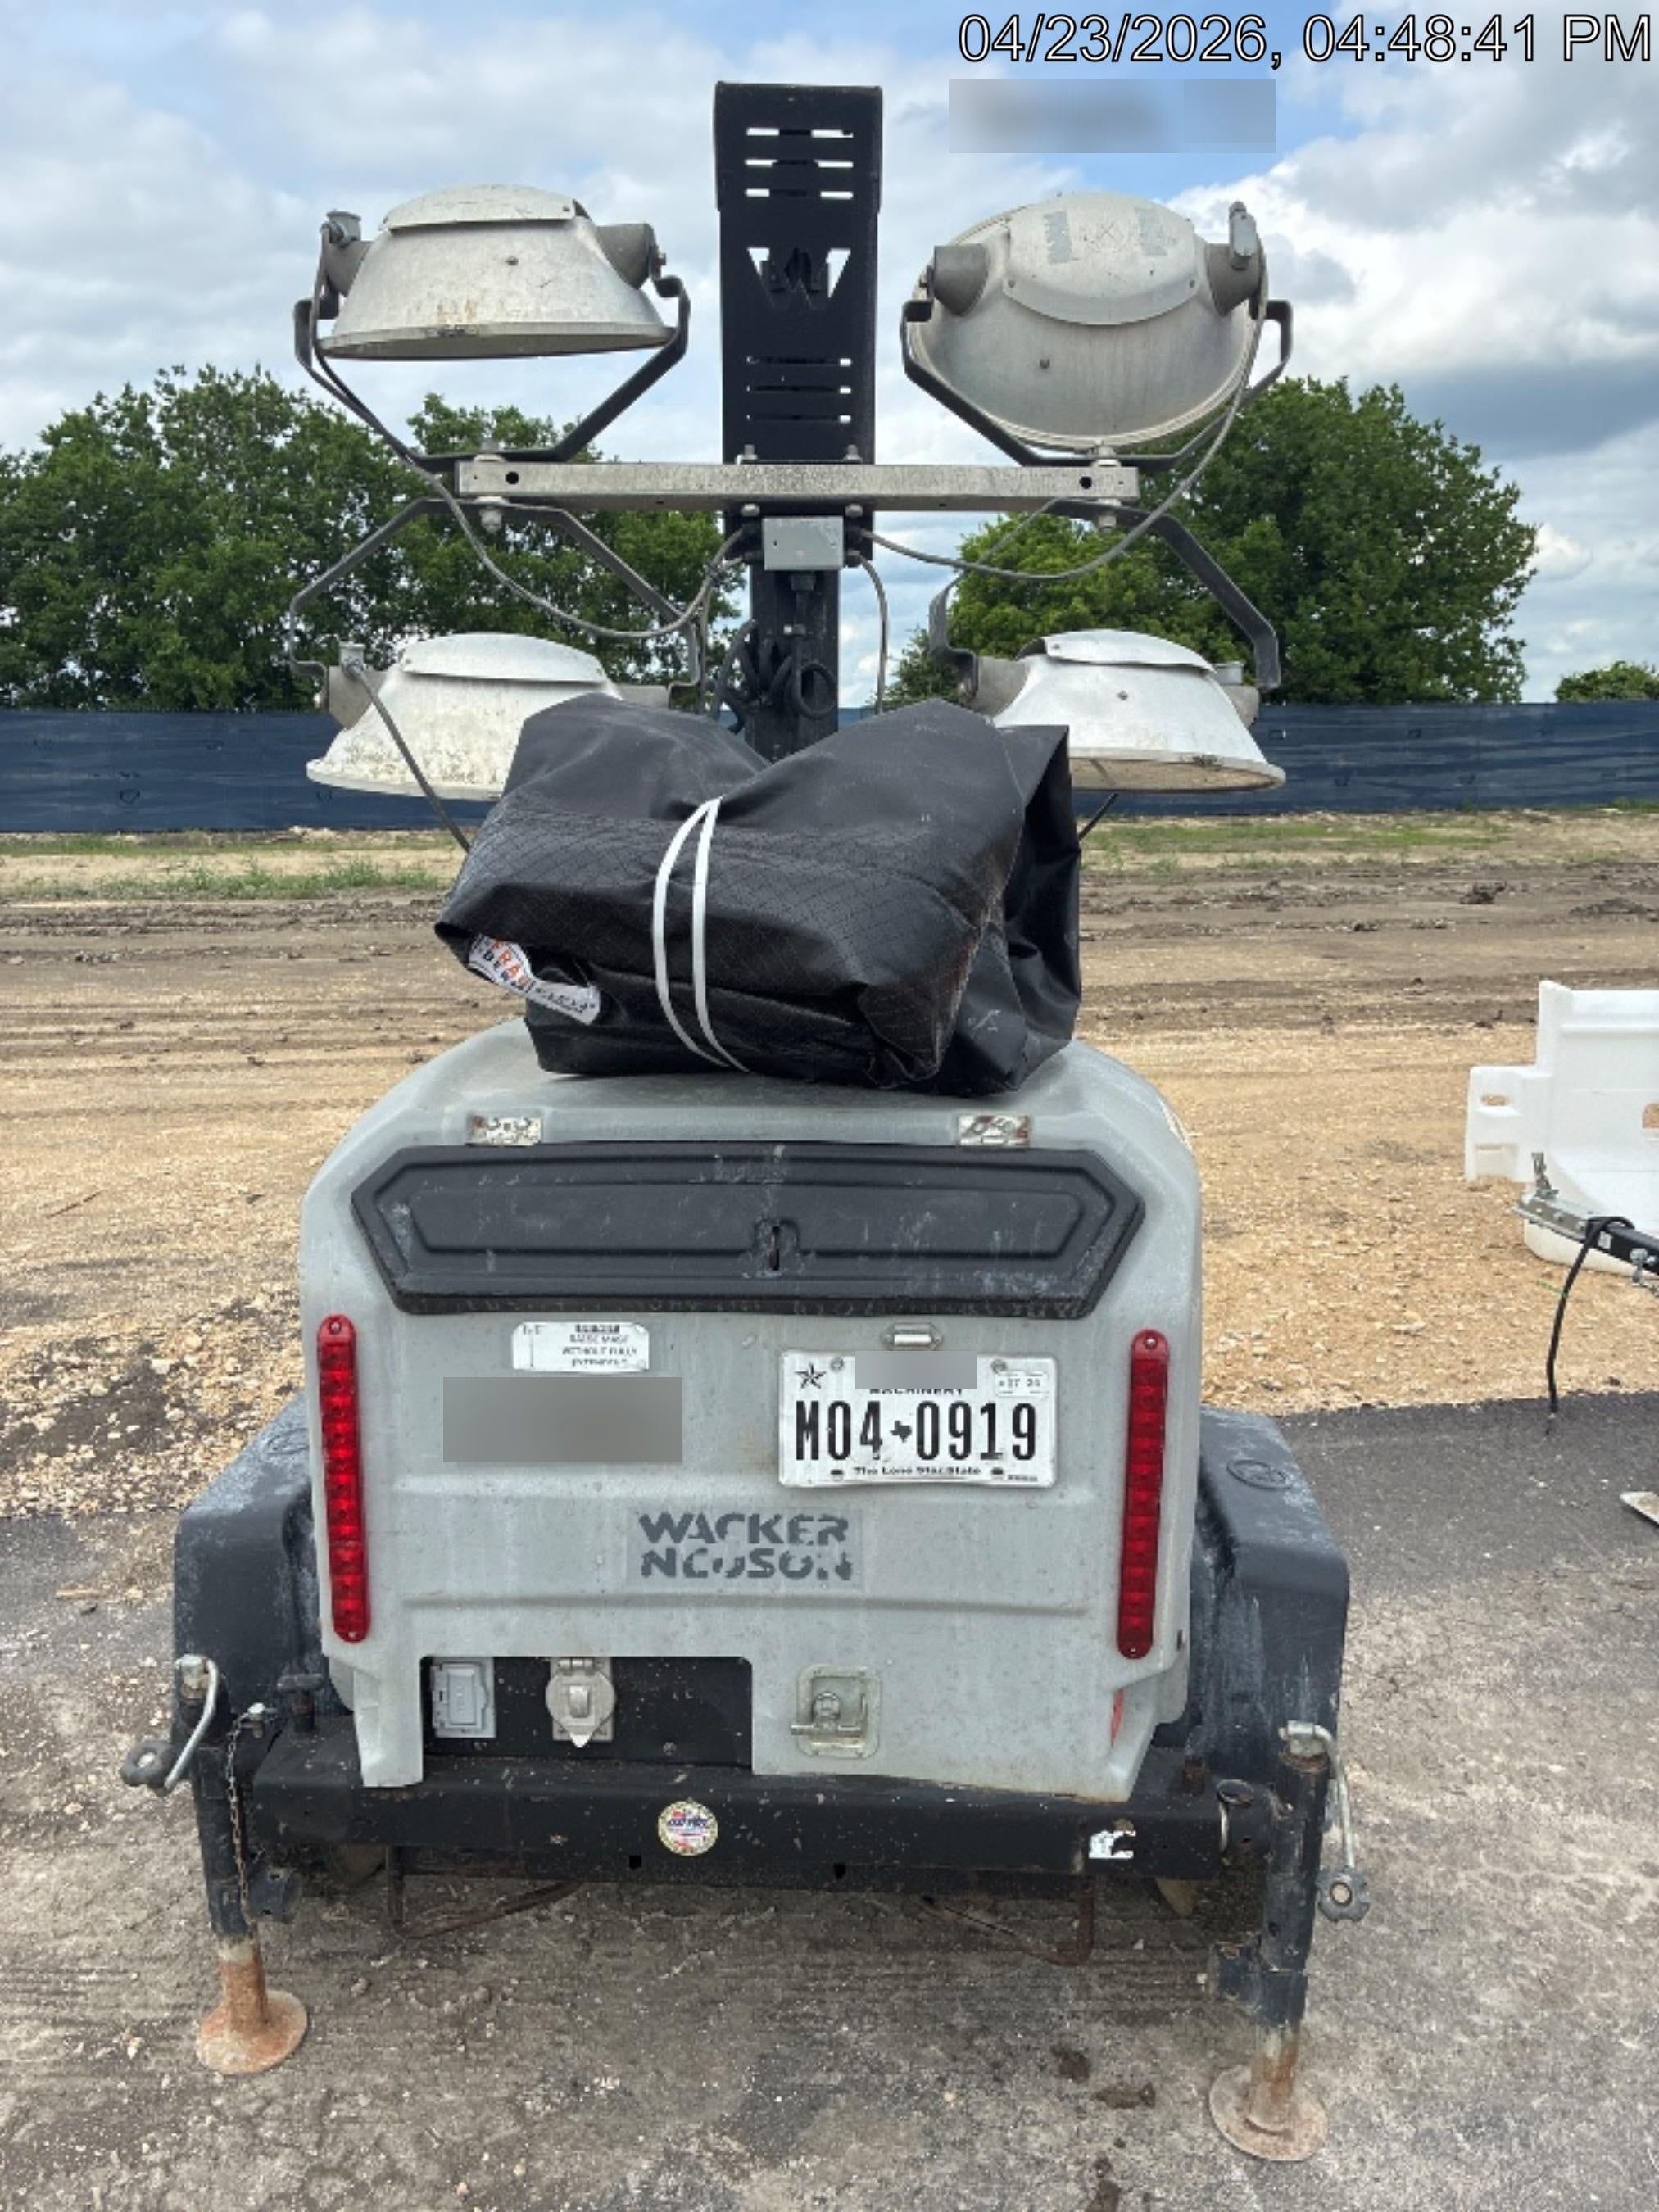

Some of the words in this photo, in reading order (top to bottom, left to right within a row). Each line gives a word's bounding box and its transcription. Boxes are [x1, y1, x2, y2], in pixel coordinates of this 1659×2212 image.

[795, 1400, 882, 1461] M04
[916, 1401, 1036, 1461] 0919
[854, 1466, 878, 1475] The
[882, 1466, 913, 1475] Lone
[916, 1466, 942, 1475] Star
[946, 1466, 982, 1475] State
[638, 1512, 850, 1546] WACKER
